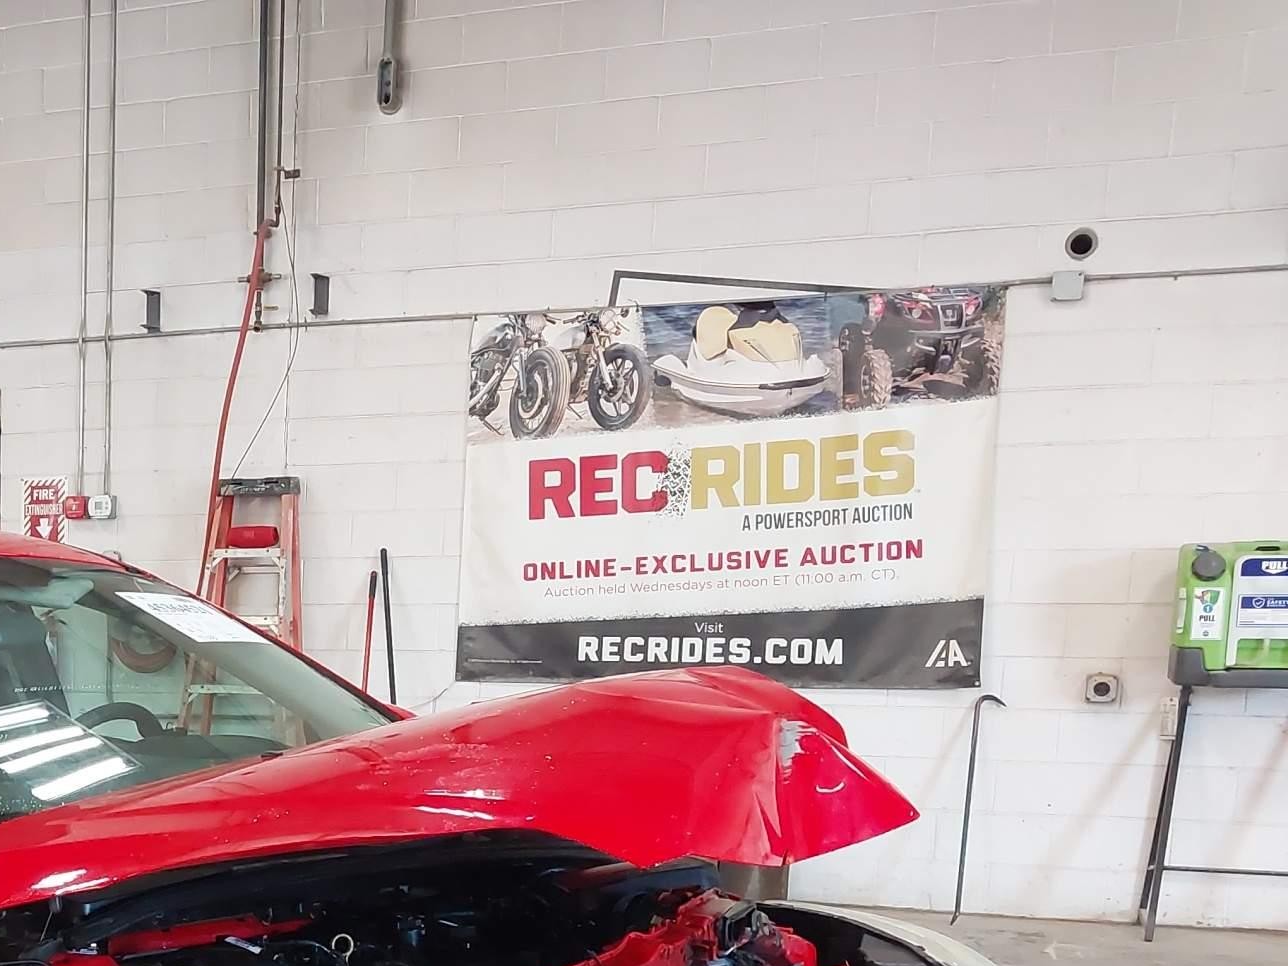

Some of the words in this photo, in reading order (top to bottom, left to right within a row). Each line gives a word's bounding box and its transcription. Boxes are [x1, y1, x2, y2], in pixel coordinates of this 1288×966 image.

[529, 450, 669, 520] REC
[691, 429, 916, 510] RIDES
[33, 488, 56, 500] FIRE
[25, 503, 64, 516] EXTINGUISHER
[742, 515, 752, 531] A
[755, 508, 849, 531] POWERSPORT
[852, 502, 913, 525] AUCTION
[523, 548, 789, 582] ONLINE-EXCLUSIVE
[799, 539, 923, 566] AUCTION
[544, 585, 594, 598] Auction
[598, 583, 626, 595] held
[630, 579, 713, 594] Wednesdays
[716, 577, 729, 588] at
[734, 578, 768, 588] noon
[773, 575, 790, 586] ET
[795, 572, 834, 587] (11:00
[694, 622, 724, 634] Visit
[1199, 614, 1215, 622] PULL
[578, 636, 843, 665] RECRIDES.COM
